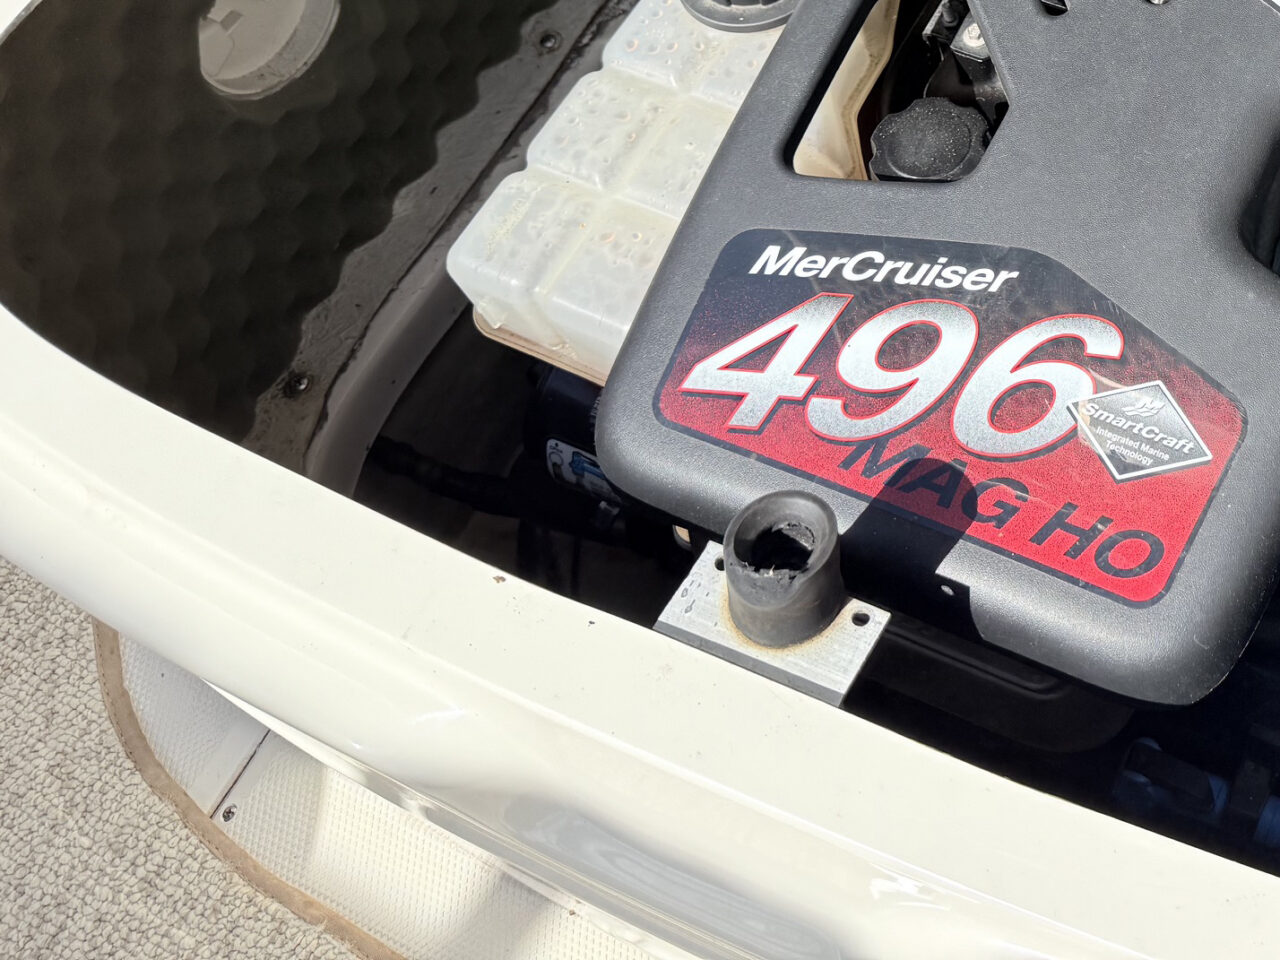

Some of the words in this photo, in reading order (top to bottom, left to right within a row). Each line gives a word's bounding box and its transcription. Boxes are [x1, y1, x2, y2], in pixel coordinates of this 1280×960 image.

[749, 245, 1019, 294] MerCruiser
[679, 293, 1124, 458] 496
[1084, 402, 1195, 454] SmartCraft
[1096, 427, 1140, 450] Integrated
[1140, 443, 1170, 461] Marine
[1105, 440, 1154, 466] Technology
[838, 439, 1029, 530] MAG
[1030, 501, 1166, 579] HO
